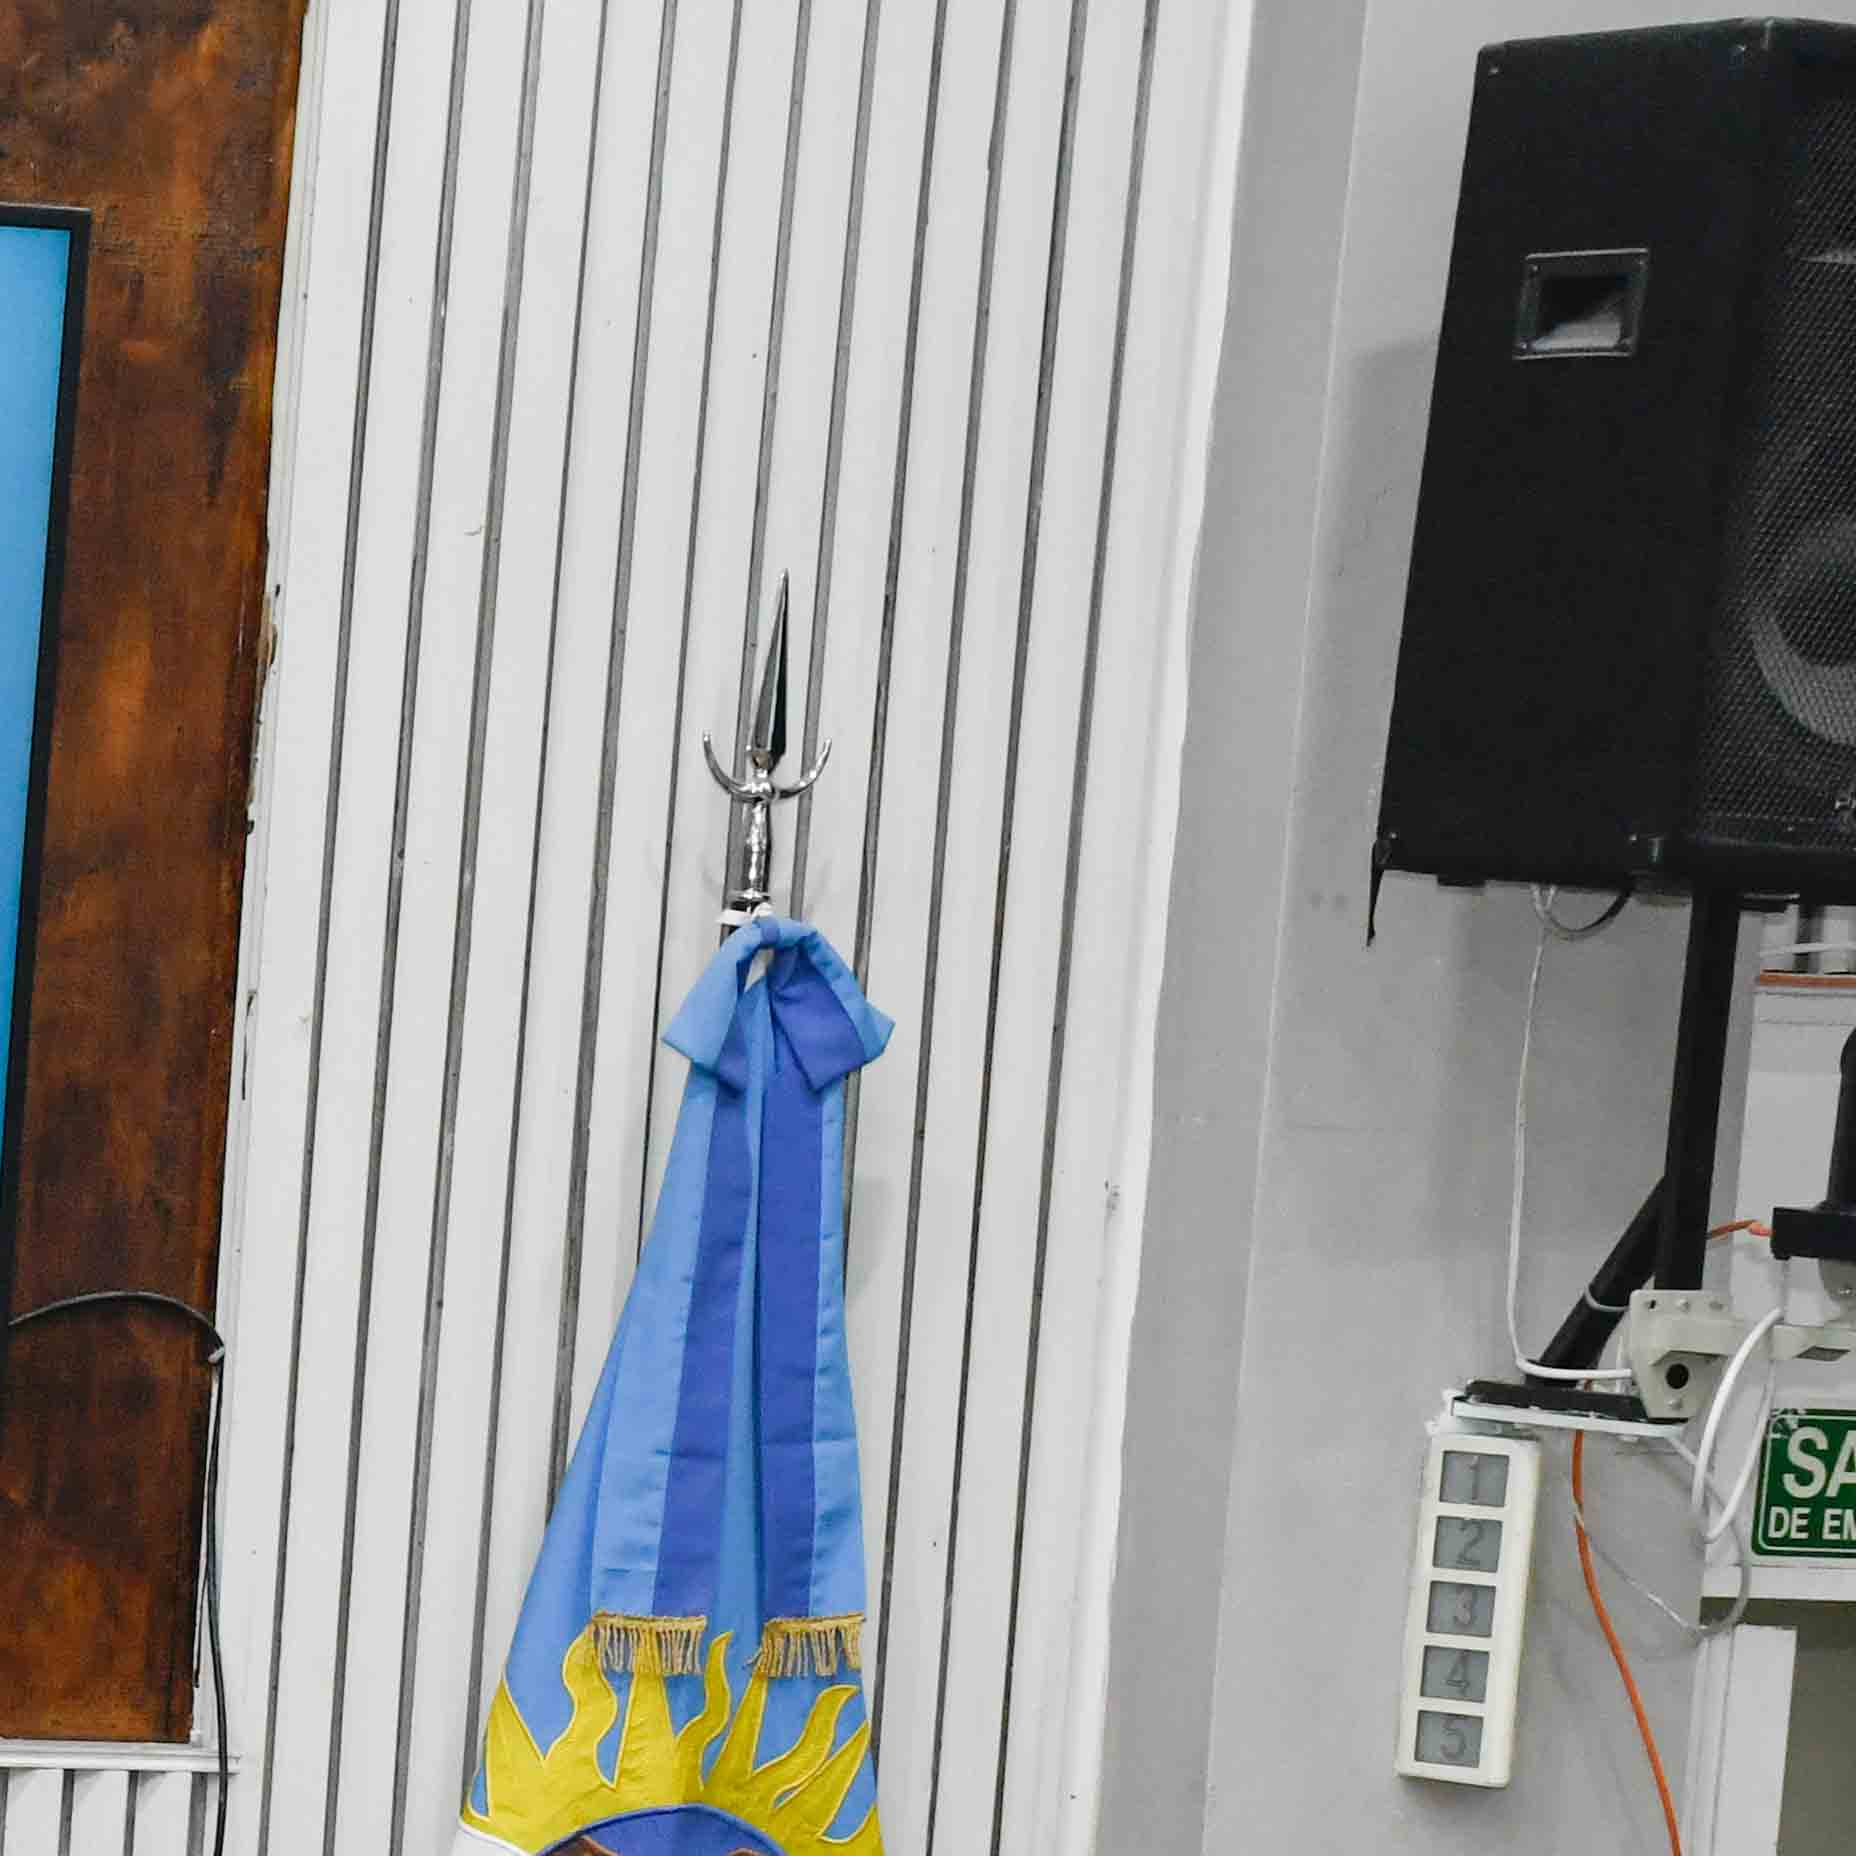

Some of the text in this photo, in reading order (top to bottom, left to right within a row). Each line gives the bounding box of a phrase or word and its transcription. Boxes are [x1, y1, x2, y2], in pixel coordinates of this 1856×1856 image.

[1467, 1456, 1480, 1500] 1
[1456, 1520, 1484, 1566] 2
[1767, 1505, 1812, 1540] DE
[1452, 1585, 1479, 1628] 3
[1445, 1650, 1471, 1697] 4
[1440, 1715, 1468, 1760] 5
